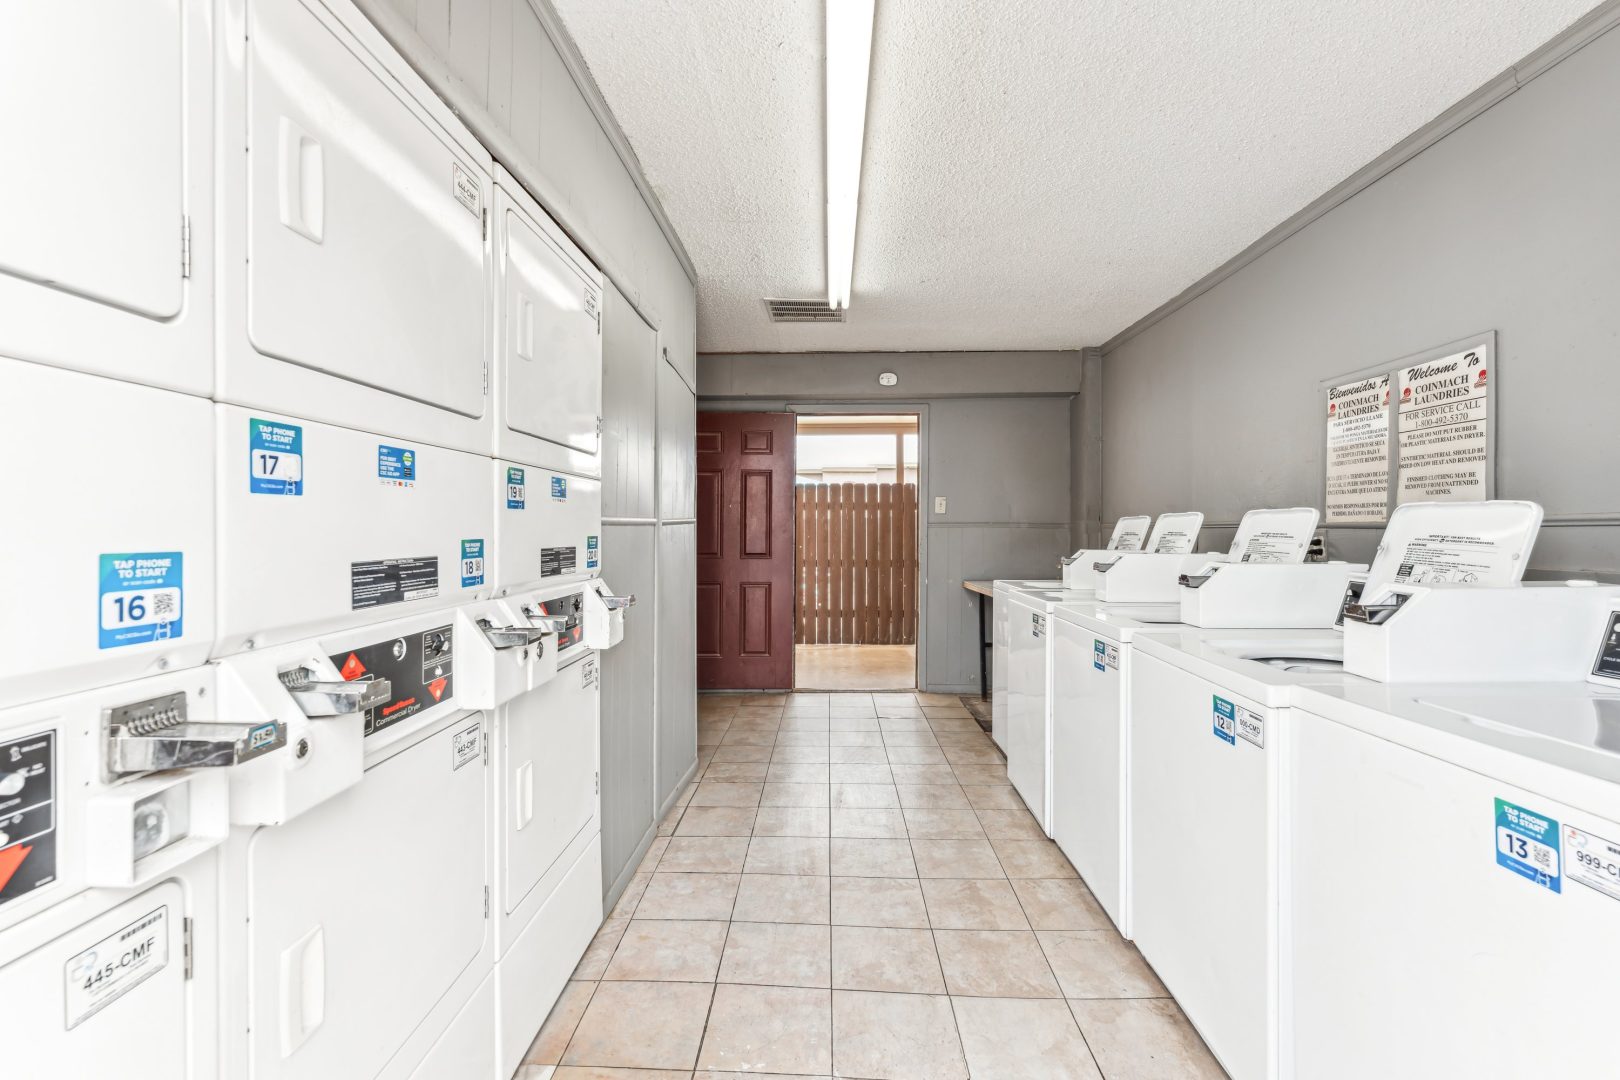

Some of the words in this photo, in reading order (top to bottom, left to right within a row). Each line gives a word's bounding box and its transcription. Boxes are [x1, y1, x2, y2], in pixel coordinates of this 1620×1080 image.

[1407, 362, 1458, 382] Welcome
[1463, 352, 1480, 368] To
[1329, 380, 1376, 400] Bienvenidos
[1415, 374, 1469, 395] COINMACH
[1338, 393, 1379, 410] COINMACH
[1414, 386, 1470, 405] LAUNDRIES
[1338, 404, 1379, 420] LAUNDRIES
[1405, 412, 1420, 421] FOR
[1421, 405, 1454, 418] SERVICE
[1456, 400, 1481, 412] CALL
[1415, 412, 1469, 428] 1-800-492-5370
[258, 425, 272, 434] TAP
[273, 428, 296, 438] PHONE
[272, 435, 294, 444] START
[1408, 432, 1424, 440] PLEASE
[1454, 425, 1477, 433] RUBBER
[1428, 435, 1456, 444] MATERIALS
[1464, 432, 1486, 440] DRYER.
[260, 454, 279, 475] 17
[510, 486, 518, 498] 19
[1442, 479, 1478, 487] UNATTENDED
[113, 560, 135, 570] TAP
[136, 558, 172, 568] PHONE
[118, 570, 134, 578] TO
[135, 568, 168, 578] START
[465, 561, 474, 575] 18
[114, 595, 146, 622] 16
[376, 706, 408, 726] Commercial
[408, 703, 421, 715] Dryer
[1217, 715, 1224, 730] 12
[1504, 806, 1518, 816] TAP
[1520, 810, 1549, 829] PHONE
[1507, 814, 1518, 823] TO
[1519, 818, 1546, 834] START
[1506, 833, 1528, 859] 13
[1576, 850, 1620, 878] 999-C
[82, 936, 156, 990] 445-CMF
